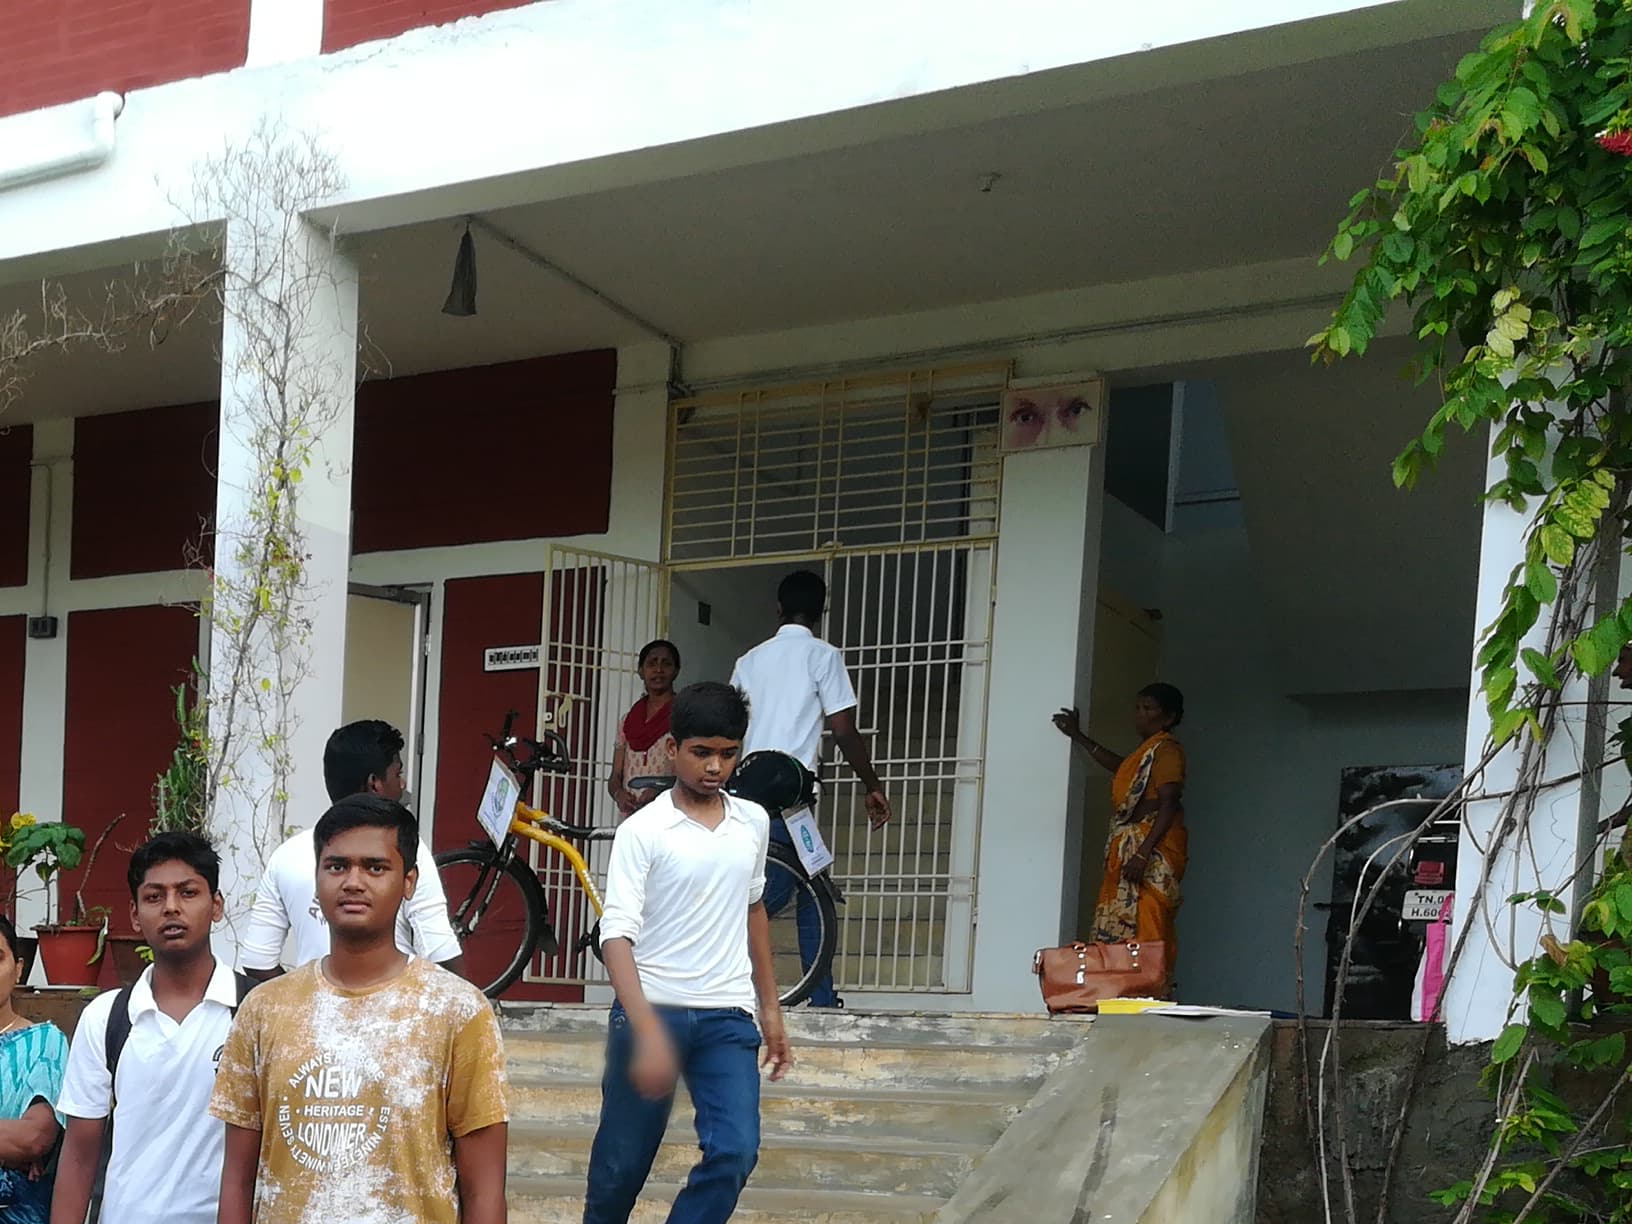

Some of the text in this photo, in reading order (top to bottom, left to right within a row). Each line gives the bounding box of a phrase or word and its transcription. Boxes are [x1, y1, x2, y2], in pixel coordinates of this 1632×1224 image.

[288, 1052, 333, 1089] ALWAYS
[304, 1065, 362, 1098] NEW
[279, 1104, 295, 1146] SEVEN
[304, 1105, 365, 1117] HERITAGE
[376, 1106, 390, 1133] EST
[298, 1122, 367, 1156] LONDONER
[289, 1144, 325, 1172] NINETY
